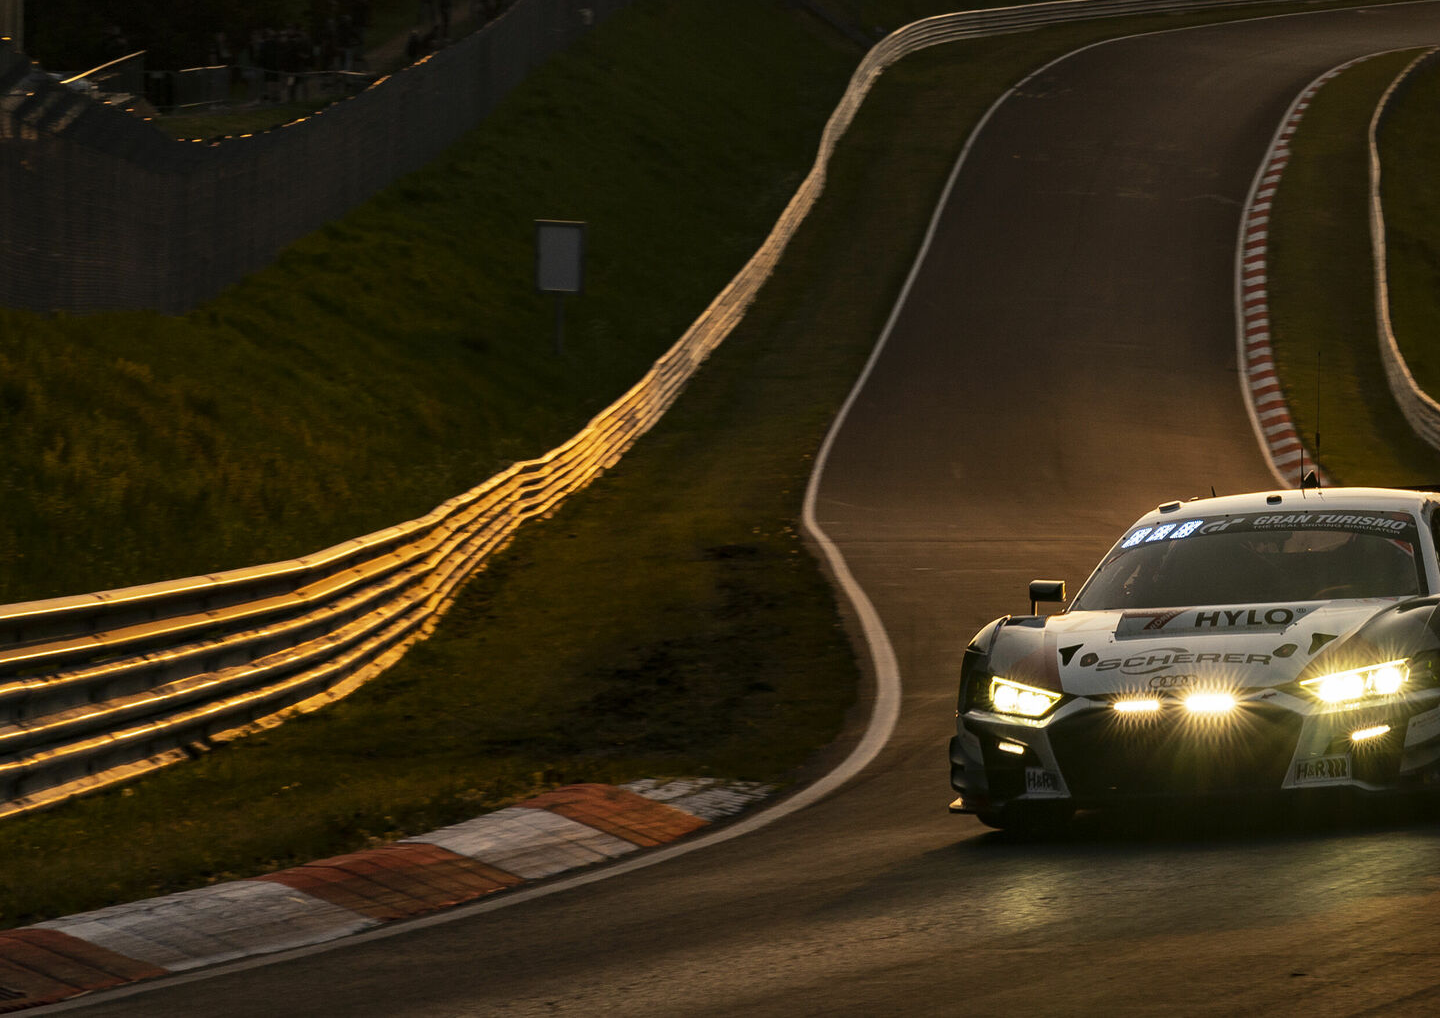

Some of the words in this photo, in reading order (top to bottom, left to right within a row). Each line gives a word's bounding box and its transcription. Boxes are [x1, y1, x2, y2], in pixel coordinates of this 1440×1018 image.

[1253, 514, 1312, 526] GRAN
[1315, 514, 1408, 530] TURISMO
[1343, 524, 1401, 535] SIMULATOR
[1195, 608, 1294, 628] HYLO
[1095, 652, 1273, 672] SCHERER
